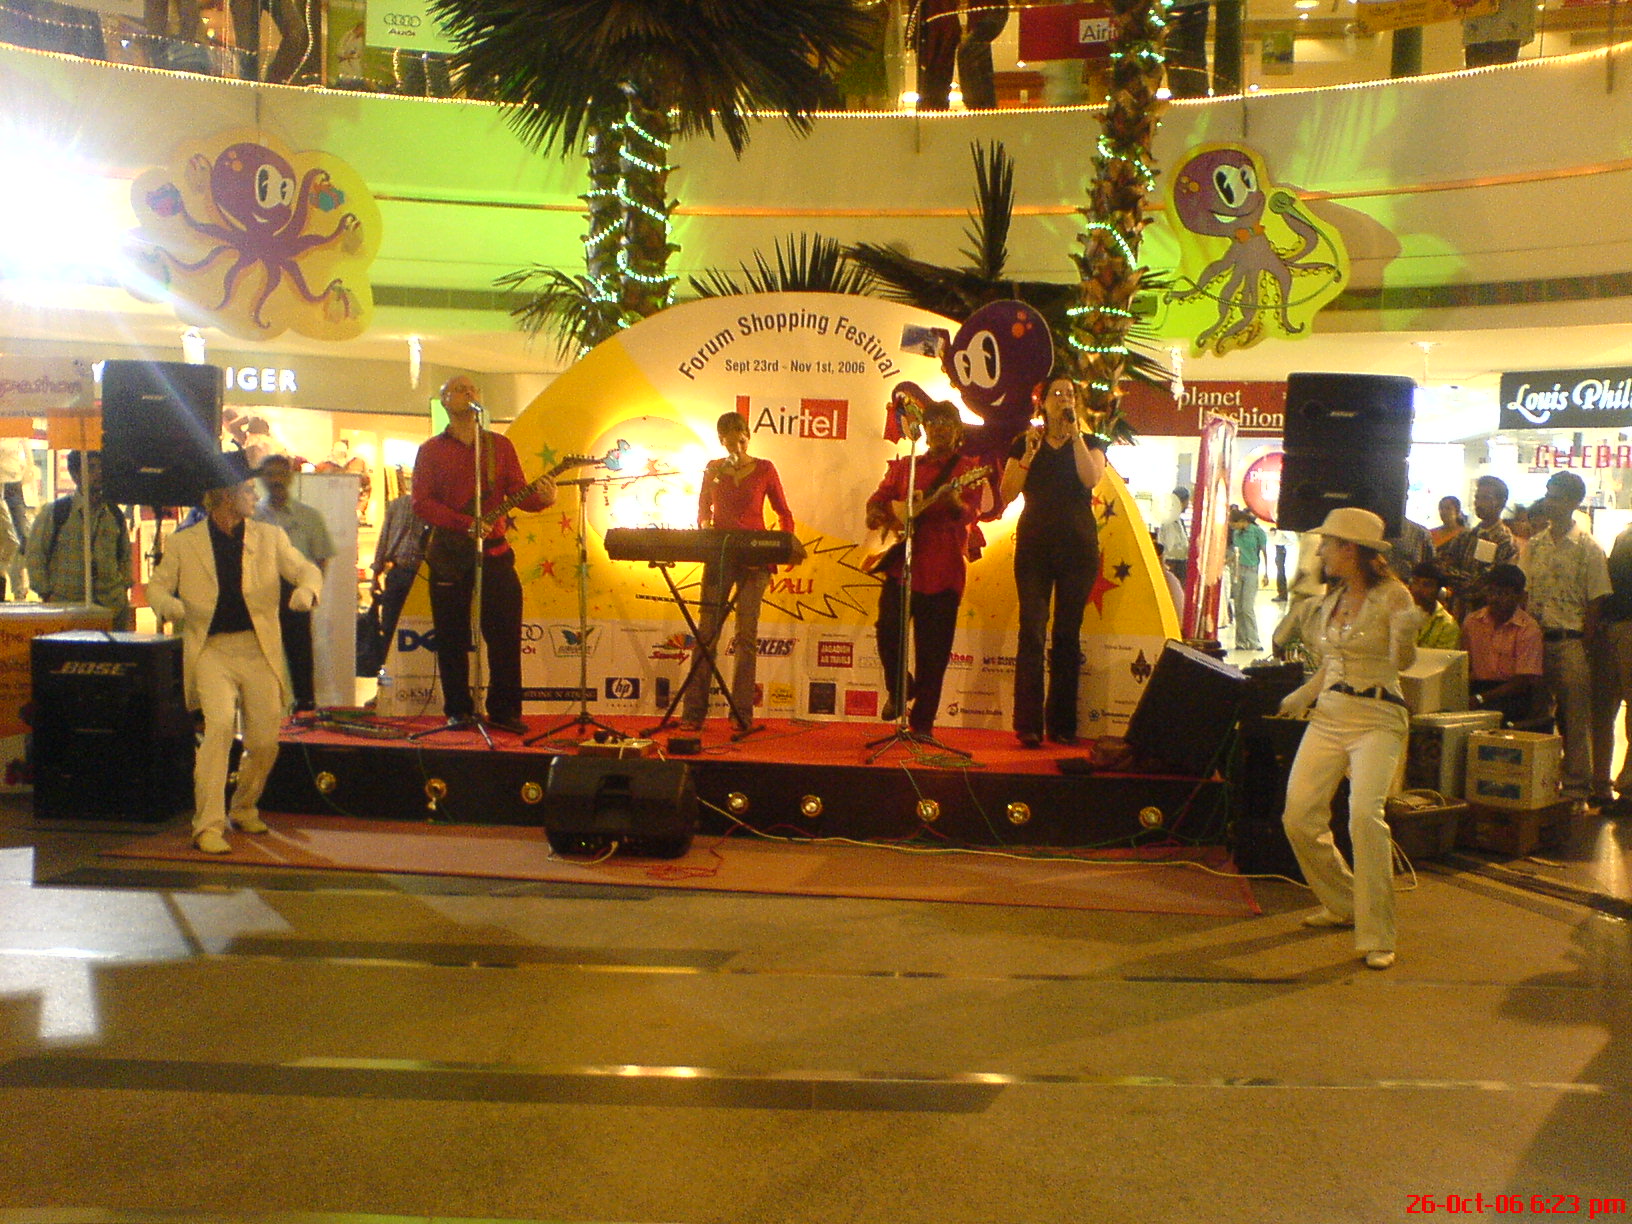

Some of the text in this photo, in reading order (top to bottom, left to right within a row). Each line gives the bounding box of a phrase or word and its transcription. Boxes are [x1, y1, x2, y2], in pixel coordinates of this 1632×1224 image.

[678, 308, 901, 381] Forum Shopping Festival
[225, 365, 298, 393] IGER
[724, 359, 750, 374] Sept
[753, 359, 779, 372] 23rd
[790, 360, 813, 373] Nov
[815, 360, 835, 374] 1st,
[838, 361, 865, 374] 2006
[1177, 386, 1242, 412] planet
[1506, 377, 1632, 424] Louis Phil
[752, 405, 838, 438] Airtel
[614, 678, 631, 700] hp
